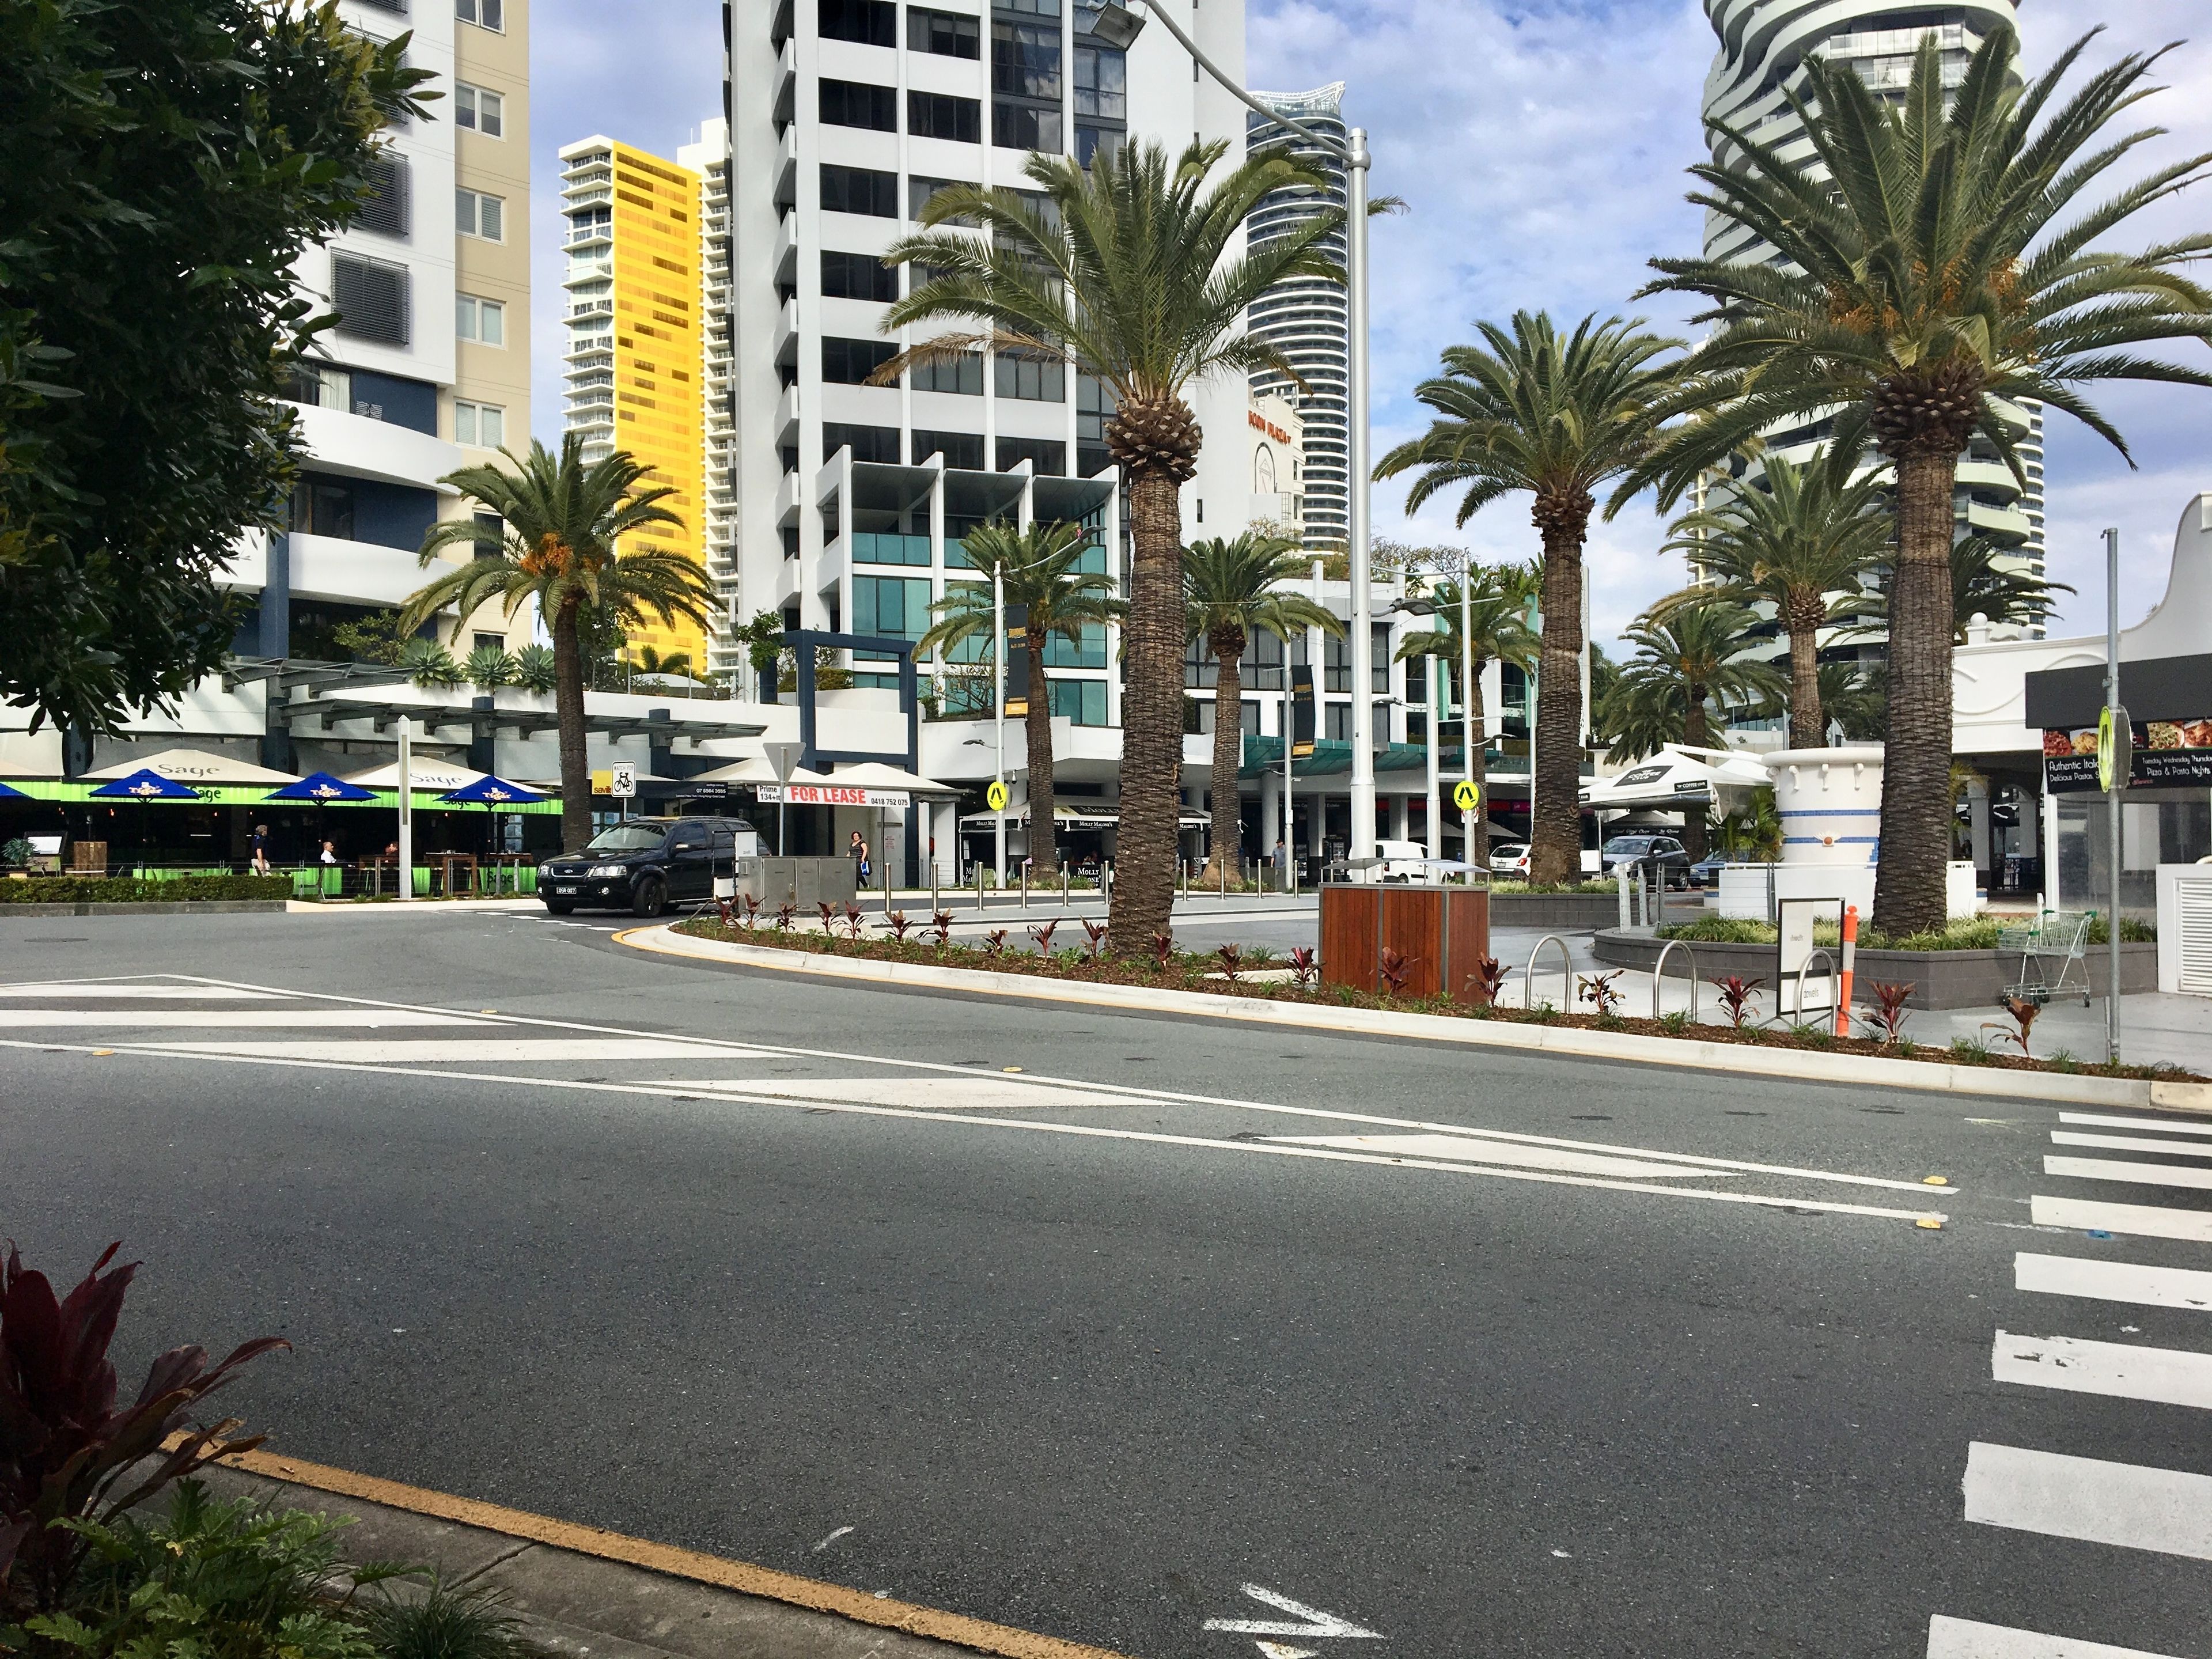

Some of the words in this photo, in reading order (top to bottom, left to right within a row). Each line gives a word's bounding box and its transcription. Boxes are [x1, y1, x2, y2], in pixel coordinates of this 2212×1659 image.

[2049, 760, 2082, 771] Authentic
[2084, 758, 2100, 769] Italia
[2191, 754, 2212, 762] Thursda
[158, 764, 220, 777] Sage
[2146, 767, 2162, 777] Pizza
[2164, 767, 2170, 776] &
[2172, 766, 2190, 775] Pasta
[2191, 766, 2211, 778] Nights
[410, 773, 463, 786] Sage
[2050, 774, 2073, 782] Delicious
[790, 786, 819, 802] FOR
[823, 787, 866, 804] LEASE
[487, 870, 514, 885] Sge
[1078, 868, 1100, 876] MOLLY
